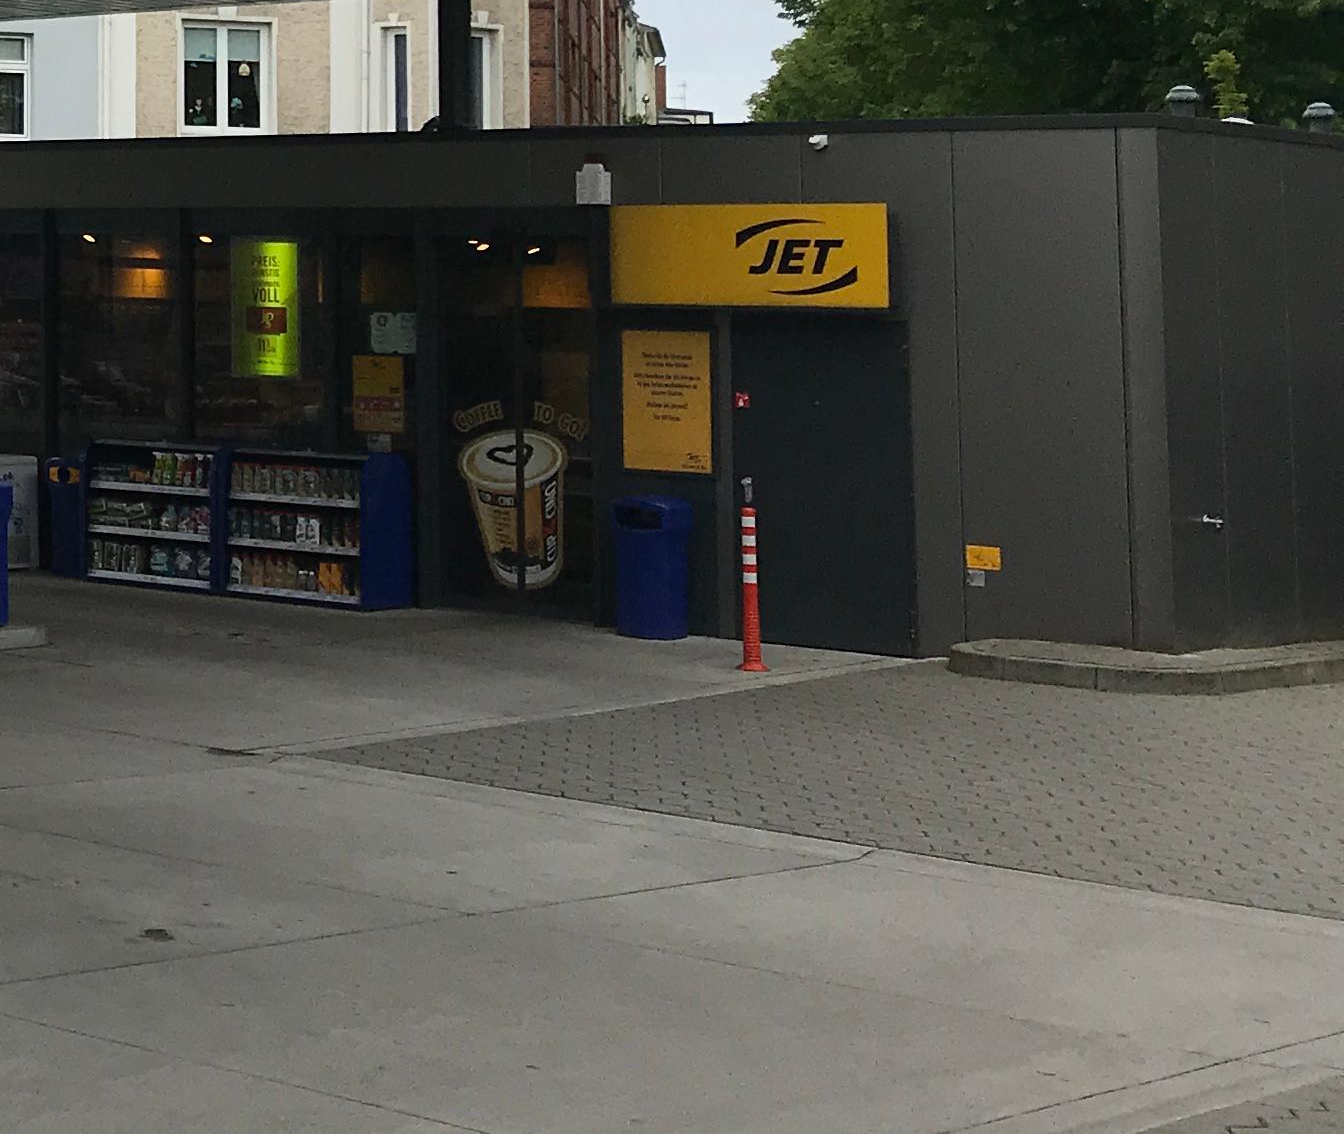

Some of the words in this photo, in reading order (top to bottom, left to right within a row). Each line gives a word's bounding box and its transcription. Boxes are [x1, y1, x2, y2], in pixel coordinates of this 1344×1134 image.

[748, 239, 845, 275] JET
[252, 287, 280, 303] VOLL
[454, 402, 503, 432] COFFEE
[535, 402, 553, 423] TO
